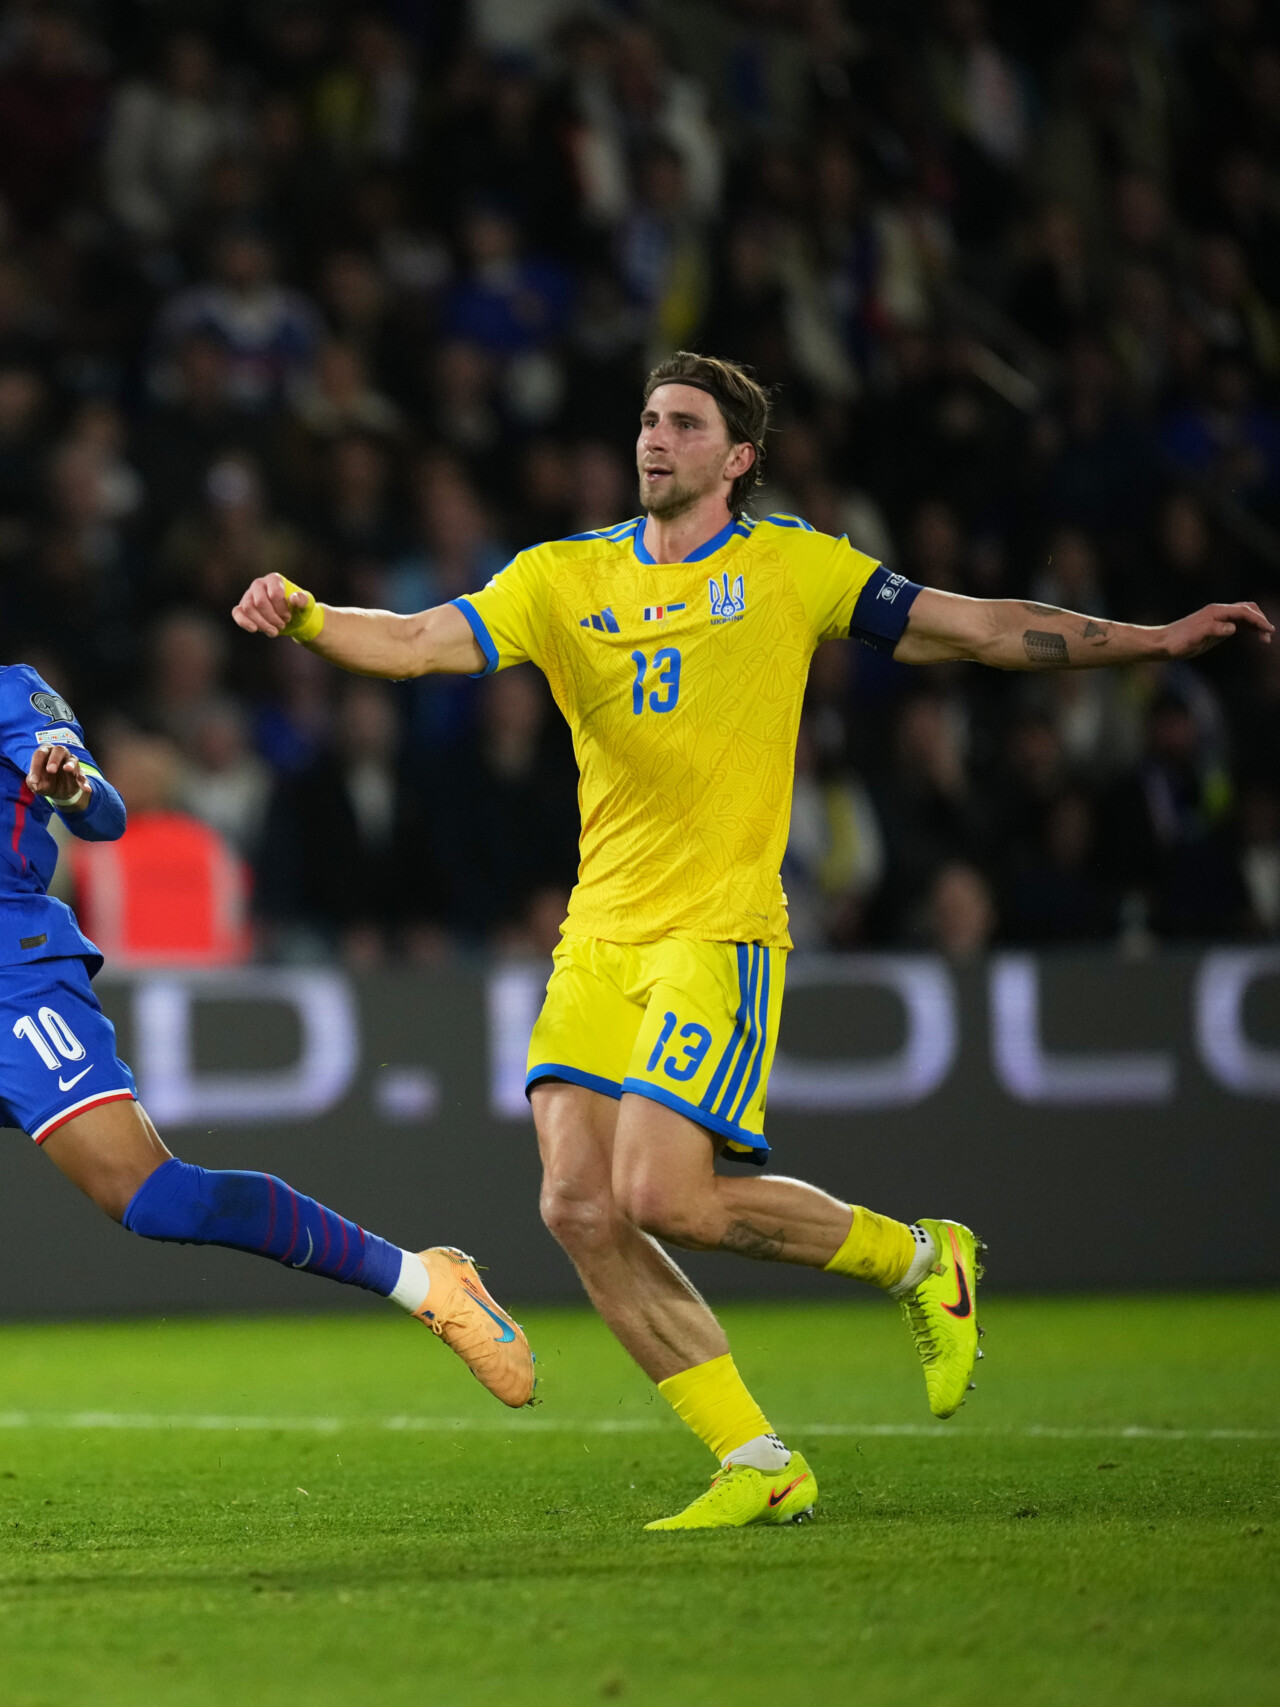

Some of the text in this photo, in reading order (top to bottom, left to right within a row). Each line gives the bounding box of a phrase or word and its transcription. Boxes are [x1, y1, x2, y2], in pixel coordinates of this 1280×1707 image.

[631, 647, 682, 715] 13
[12, 1006, 87, 1071] 10
[646, 1011, 713, 1082] 13
